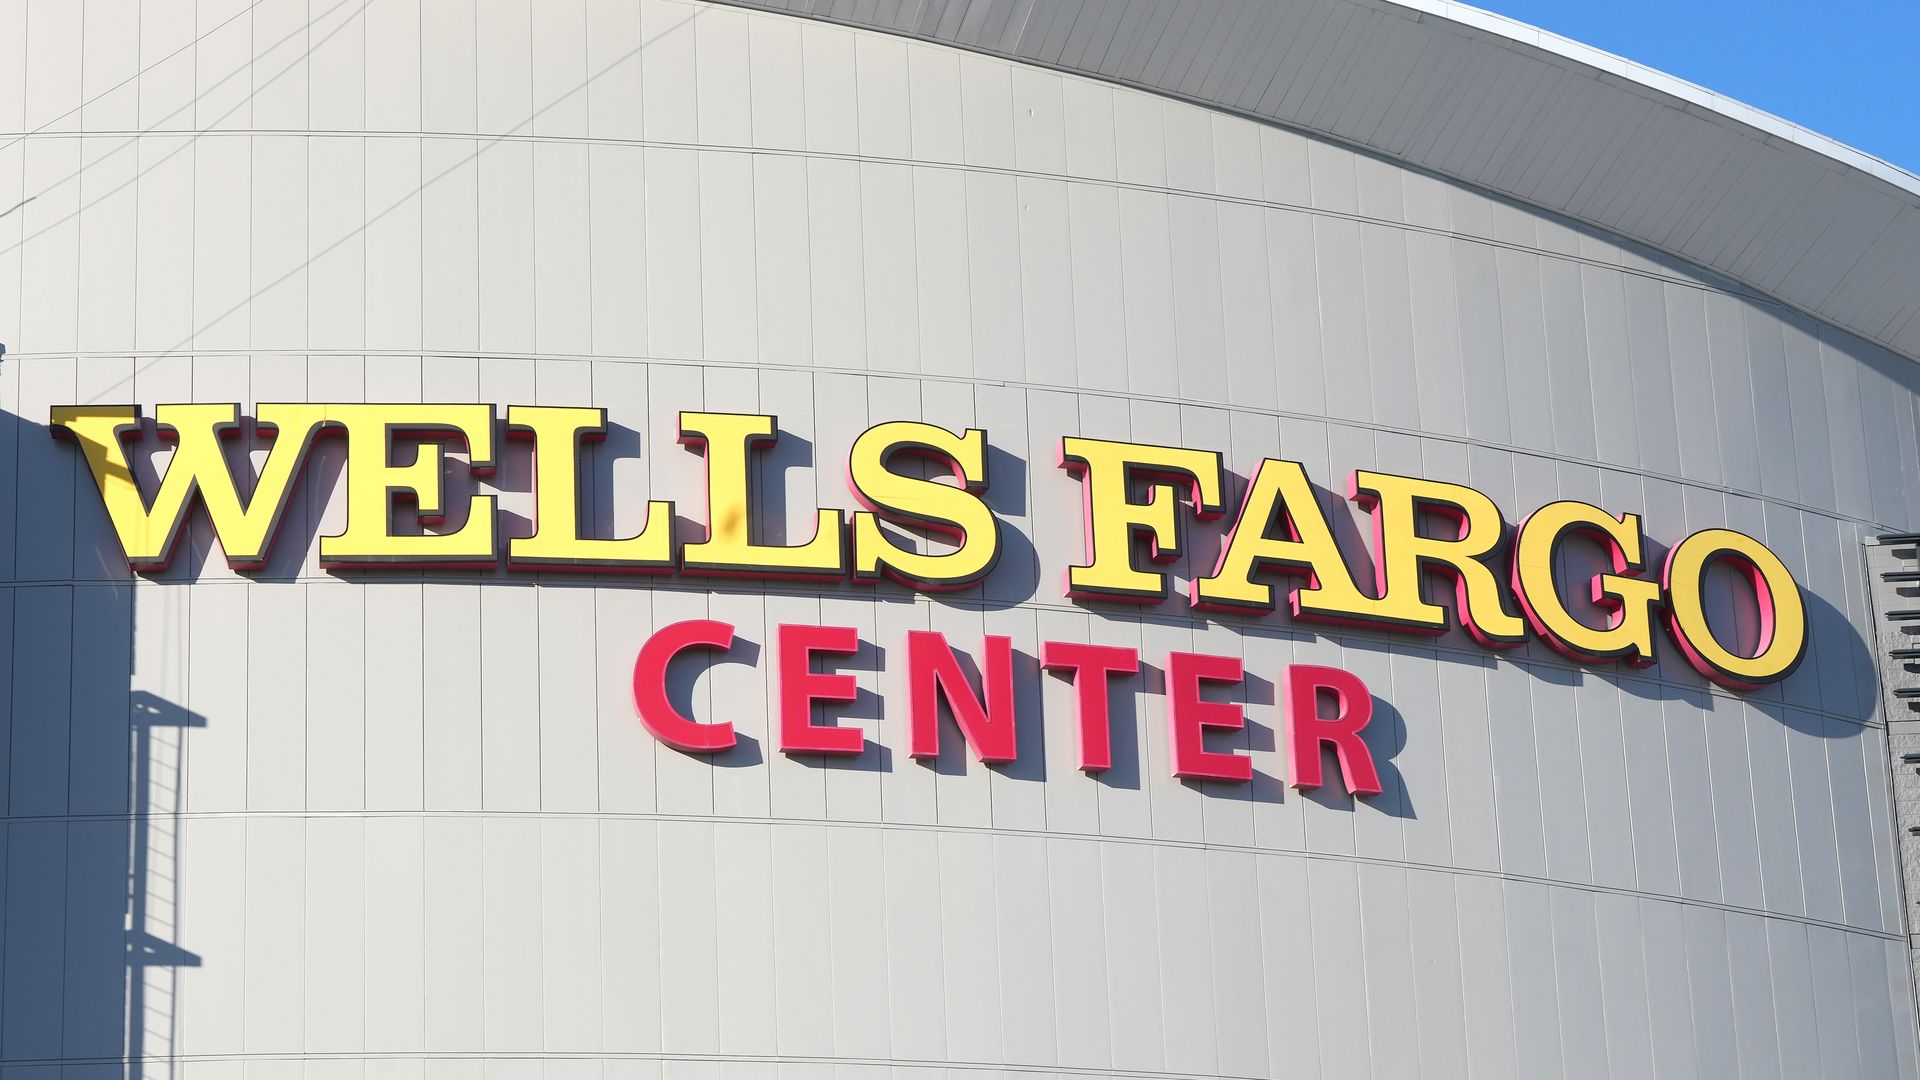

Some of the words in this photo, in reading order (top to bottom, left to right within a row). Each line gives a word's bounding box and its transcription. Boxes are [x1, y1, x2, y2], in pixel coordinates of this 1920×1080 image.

[50, 402, 1001, 588] WELLS
[1060, 436, 1808, 687] FARGO
[633, 619, 1384, 797] CENTER
